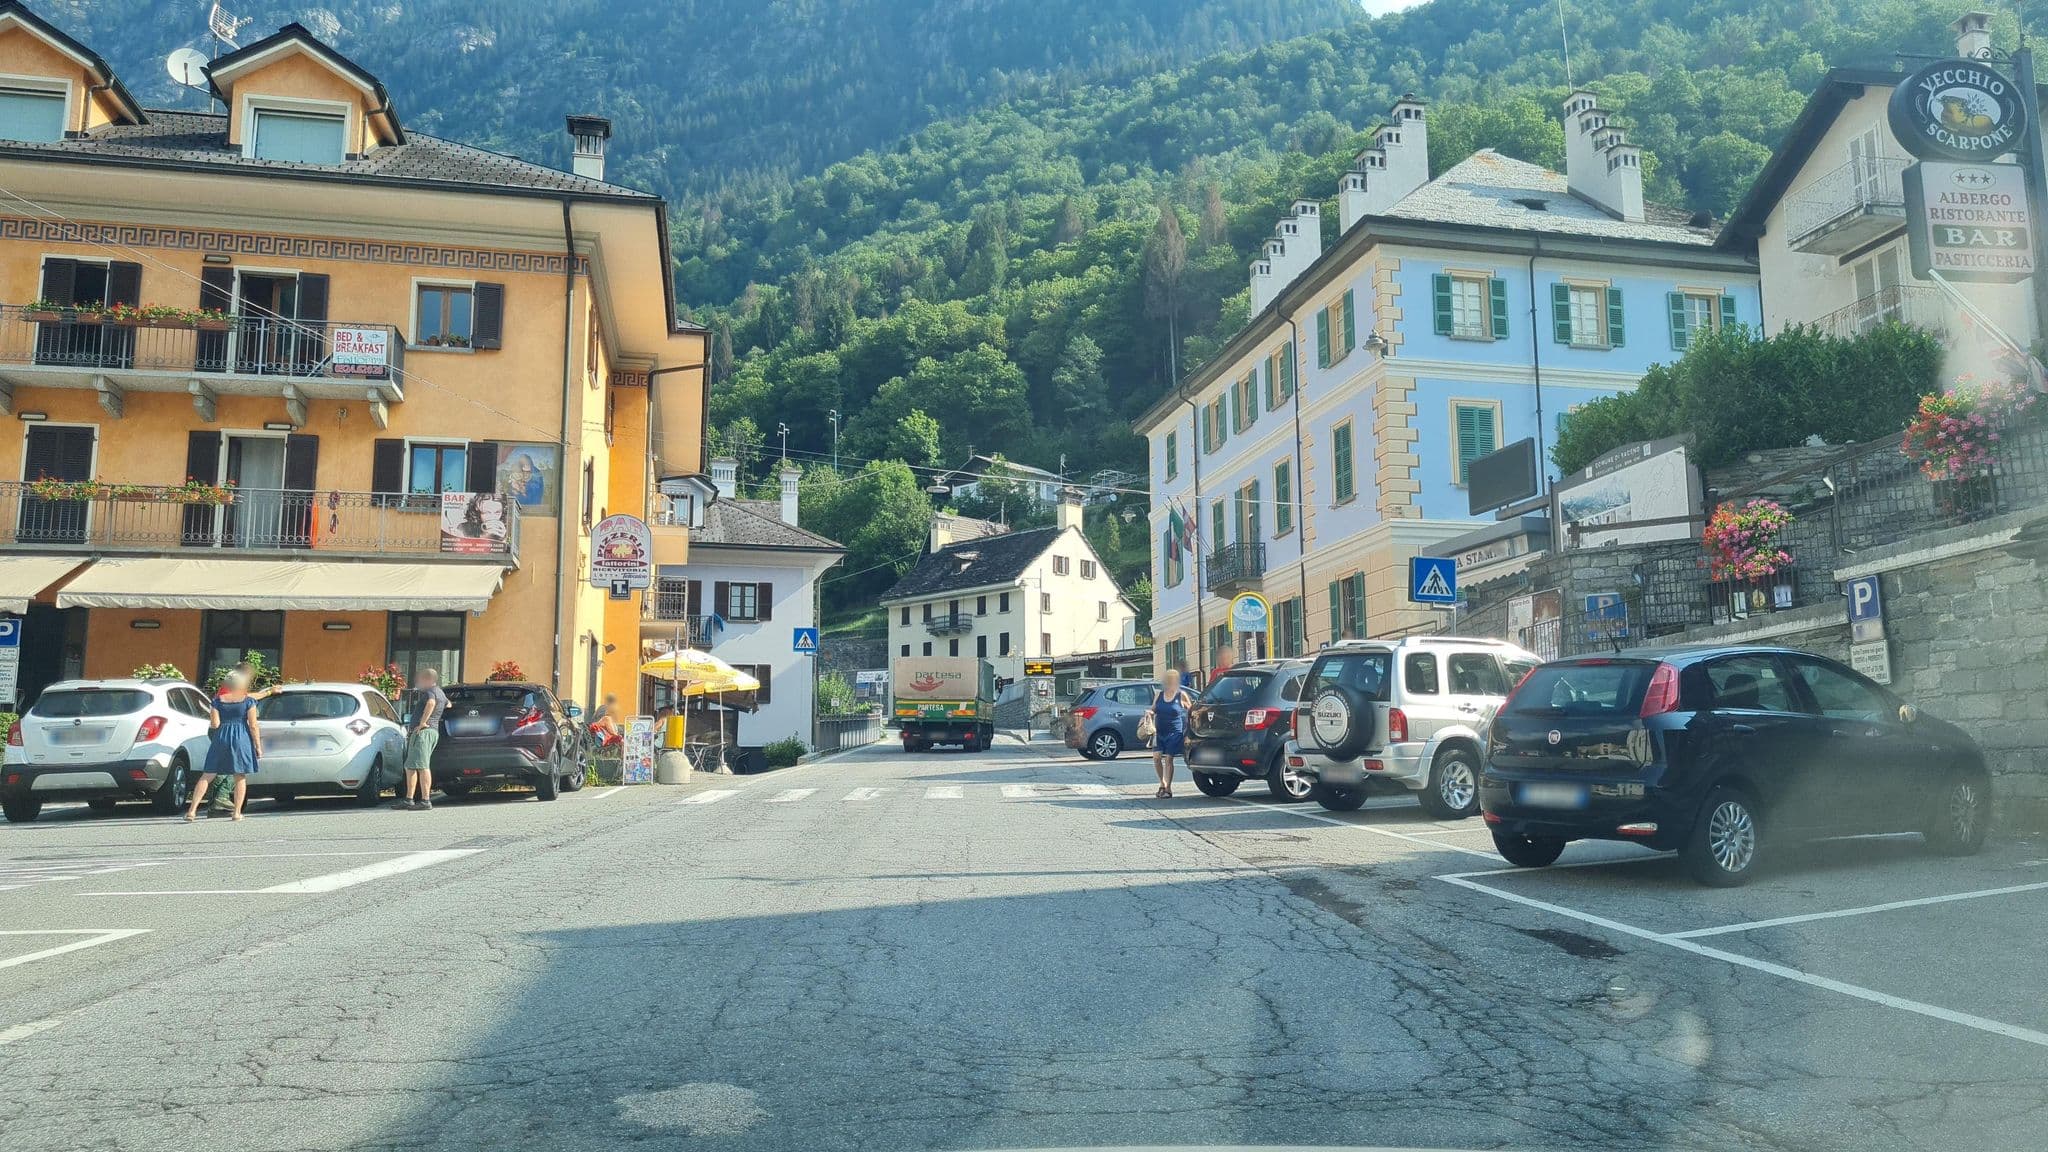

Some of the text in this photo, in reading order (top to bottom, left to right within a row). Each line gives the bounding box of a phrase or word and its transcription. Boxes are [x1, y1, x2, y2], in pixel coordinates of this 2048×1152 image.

[1919, 68, 2005, 96] VECCHIO
[1926, 122, 2013, 151] SCARPONE
[1939, 192, 2011, 206] ALBERGO
[1930, 208, 2026, 223] RISTORANTE
[1945, 227, 2017, 247] BAR
[1935, 252, 2031, 269] PASTICCERIA
[337, 331, 363, 343] BED &
[336, 343, 384, 353] BREAKFAST
[444, 494, 465, 503] BAR
[599, 517, 644, 536] BAR
[597, 532, 645, 558] PIZZERIA
[1853, 581, 1872, 616] P
[915, 672, 961, 683] partesa
[1317, 711, 1342, 719] SUZUKI
